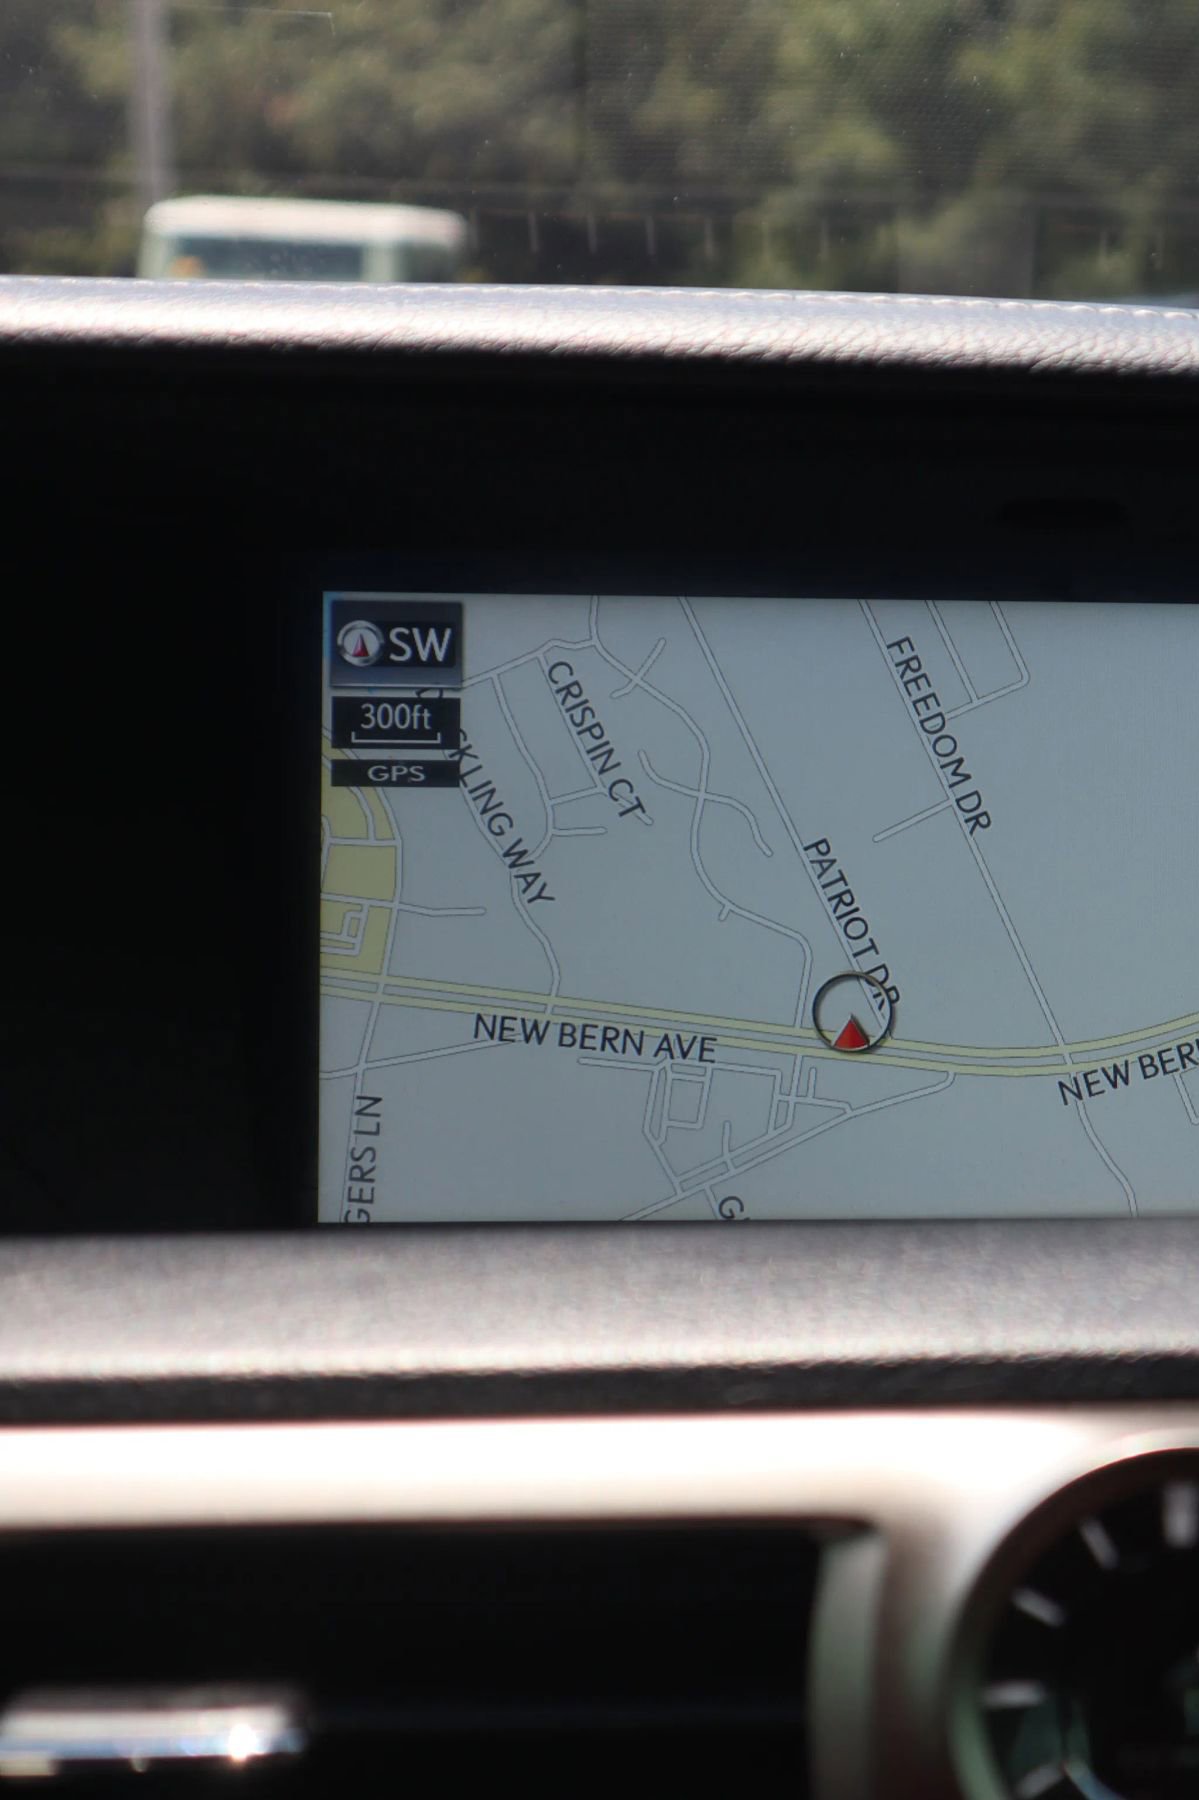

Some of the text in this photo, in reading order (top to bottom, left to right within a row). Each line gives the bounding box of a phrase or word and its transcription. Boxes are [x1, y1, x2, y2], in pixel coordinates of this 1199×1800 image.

[389, 627, 451, 662] SW
[360, 703, 432, 730] 300ft
[548, 661, 646, 819] CRISPIN CT
[886, 636, 991, 835] FREEDOM DR
[367, 765, 426, 782] GPS
[502, 838, 555, 904] WAY
[803, 838, 900, 1011] PATRIOT DR
[473, 1013, 718, 1064] NEW BERN AVE
[1057, 1059, 1132, 1106] NEW
[353, 1095, 383, 1136] LN
